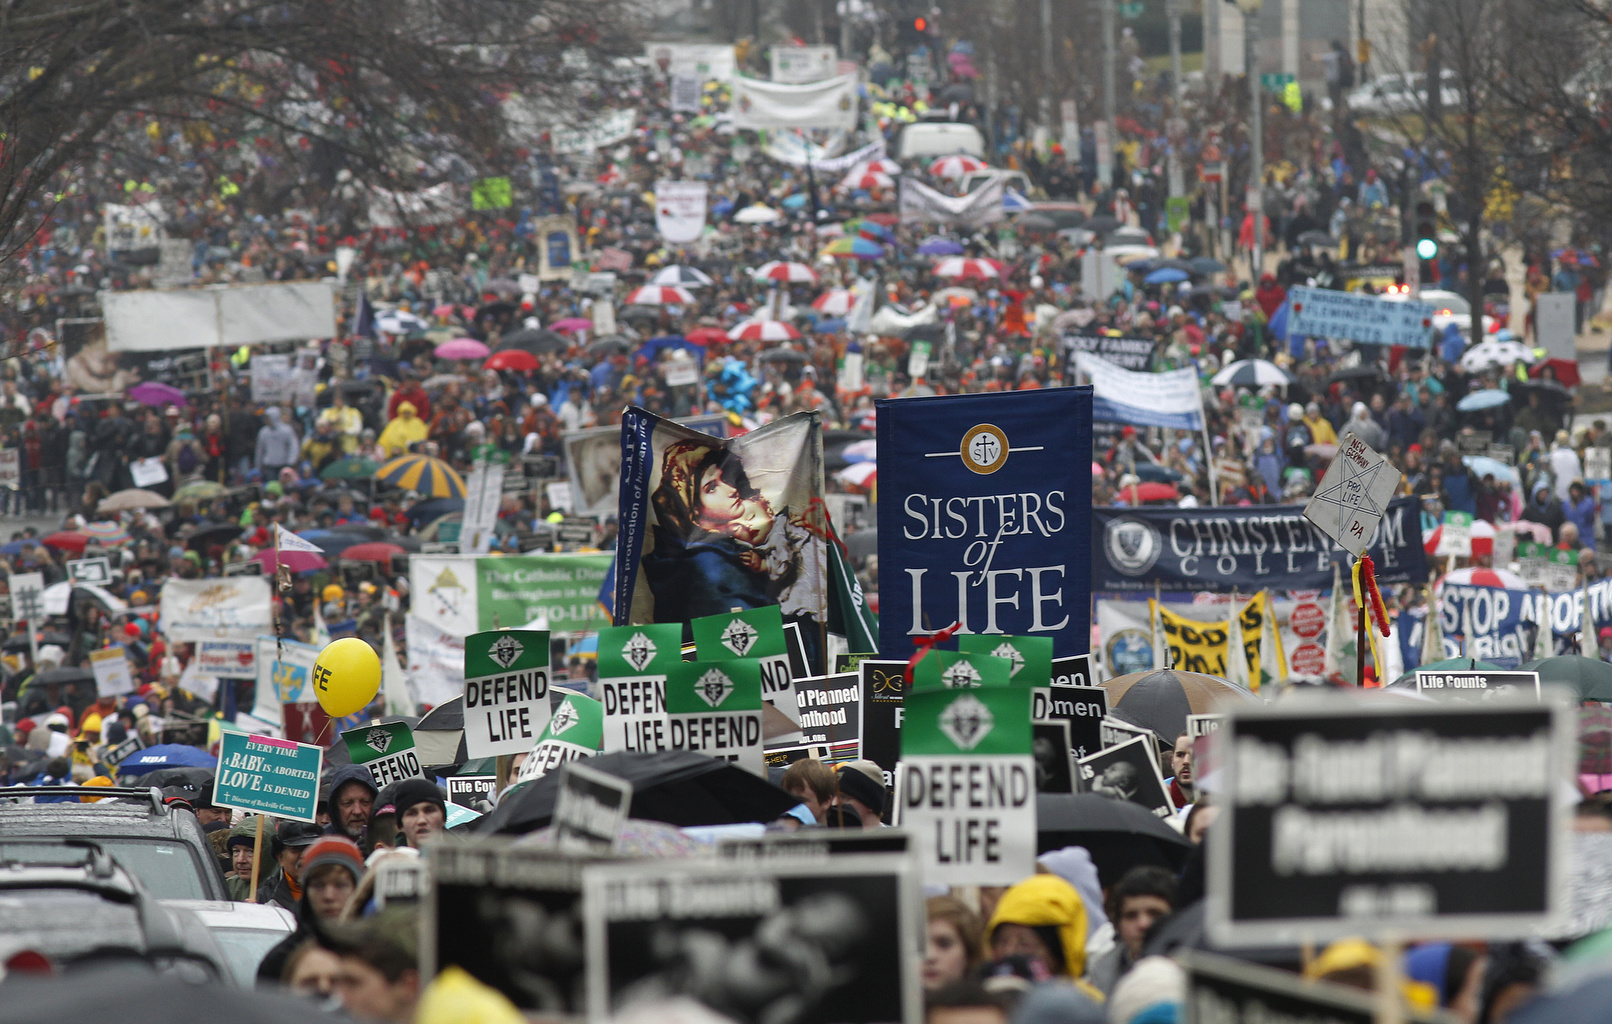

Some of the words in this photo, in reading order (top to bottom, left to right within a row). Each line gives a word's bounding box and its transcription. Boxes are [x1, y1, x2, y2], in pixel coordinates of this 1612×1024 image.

[640, 418, 648, 439] life
[637, 440, 647, 483] human
[1345, 448, 1370, 469] GERMANY
[1350, 439, 1367, 454] NEW
[634, 484, 642, 499] of
[1342, 492, 1361, 506] LIFE
[1346, 480, 1361, 493] PRO
[903, 490, 1065, 540] SISTERS
[1350, 521, 1364, 539] PA
[624, 501, 640, 571] protection
[1169, 507, 1407, 557] CHRISTENM
[963, 520, 1014, 587] of
[513, 567, 573, 584] Catholic
[904, 564, 1070, 636] LIFE
[1443, 585, 1510, 635] STOP
[313, 662, 333, 692] FE
[466, 671, 547, 708] DEFEND
[1421, 675, 1444, 689] Life
[1445, 675, 1488, 689] Counts
[806, 685, 859, 706] Planned
[487, 707, 532, 742] LIFE
[624, 720, 665, 752] LIFE
[671, 716, 760, 750] DEFEND
[1193, 721, 1218, 736] Life
[246, 741, 275, 754] EVERY
[276, 746, 299, 758] TIME
[222, 757, 229, 765] A
[229, 752, 265, 772] BABY
[262, 763, 272, 773] IS
[272, 765, 316, 782] ABORTED,
[220, 769, 263, 791] LOVE
[263, 784, 273, 793] IS
[274, 785, 310, 799] DENIED
[452, 780, 473, 794] Life
[906, 763, 1030, 808] DEFEND
[936, 819, 1000, 864] LIFE
